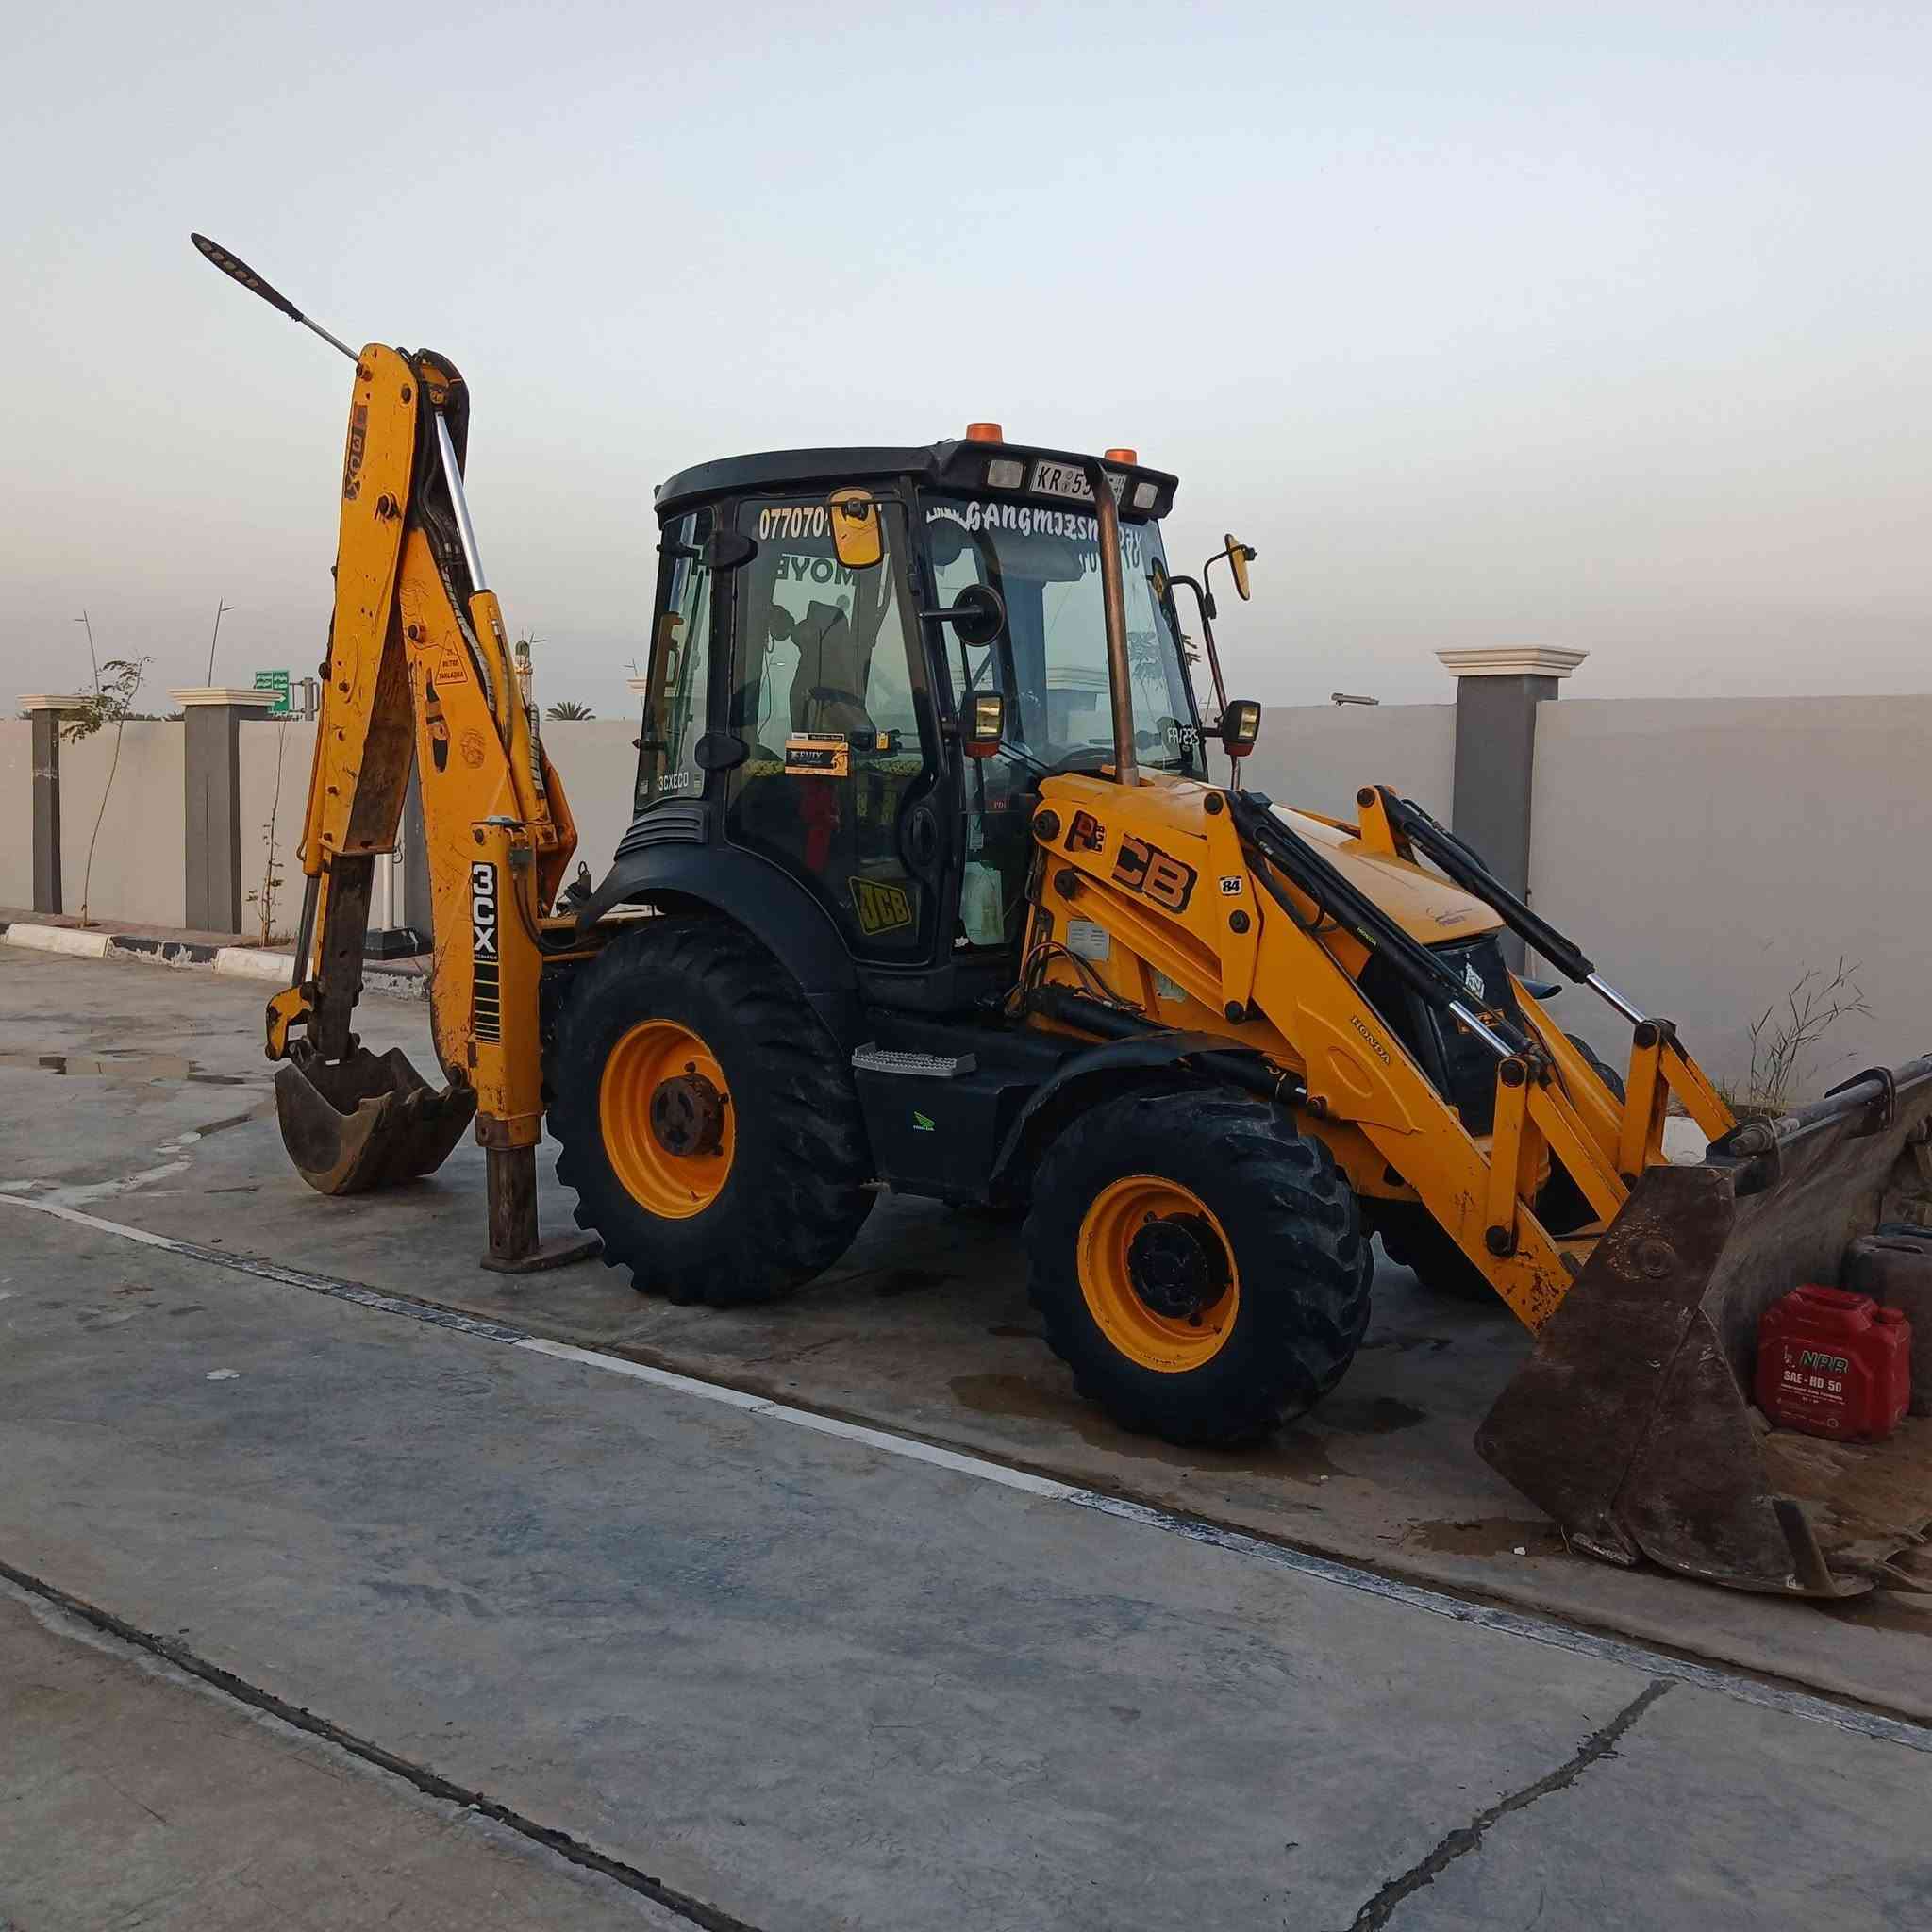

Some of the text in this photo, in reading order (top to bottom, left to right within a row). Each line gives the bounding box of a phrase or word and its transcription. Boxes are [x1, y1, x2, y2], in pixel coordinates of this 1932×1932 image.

[1037, 466, 1061, 491] KR
[1222, 879, 1241, 892] 84
[473, 864, 496, 953] 3CX
[1351, 1015, 1390, 1065] HONDA
[1827, 1380, 1842, 1393] 50
